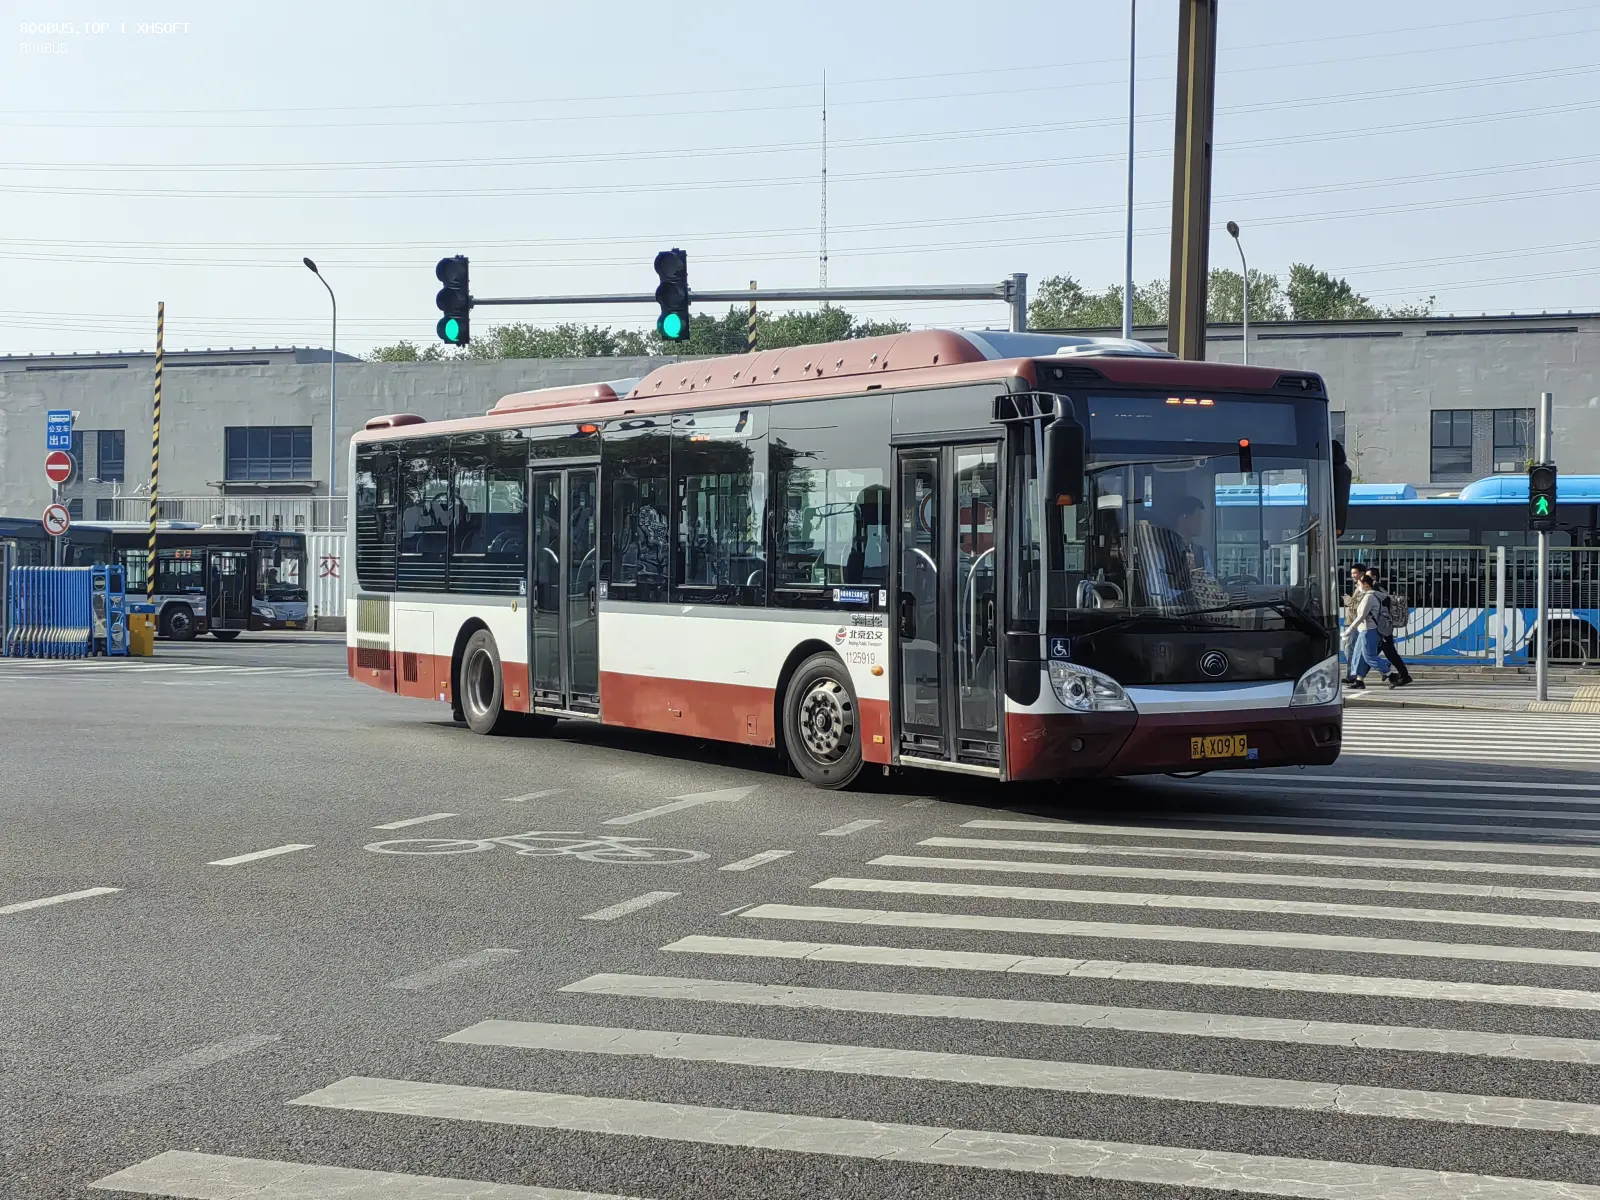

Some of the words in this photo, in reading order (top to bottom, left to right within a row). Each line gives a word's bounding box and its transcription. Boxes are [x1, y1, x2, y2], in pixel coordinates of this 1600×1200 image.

[48, 425, 69, 433] 公交车
[49, 434, 69, 445] 出口
[849, 630, 883, 640] 北京公交
[846, 651, 876, 664] 1125919
